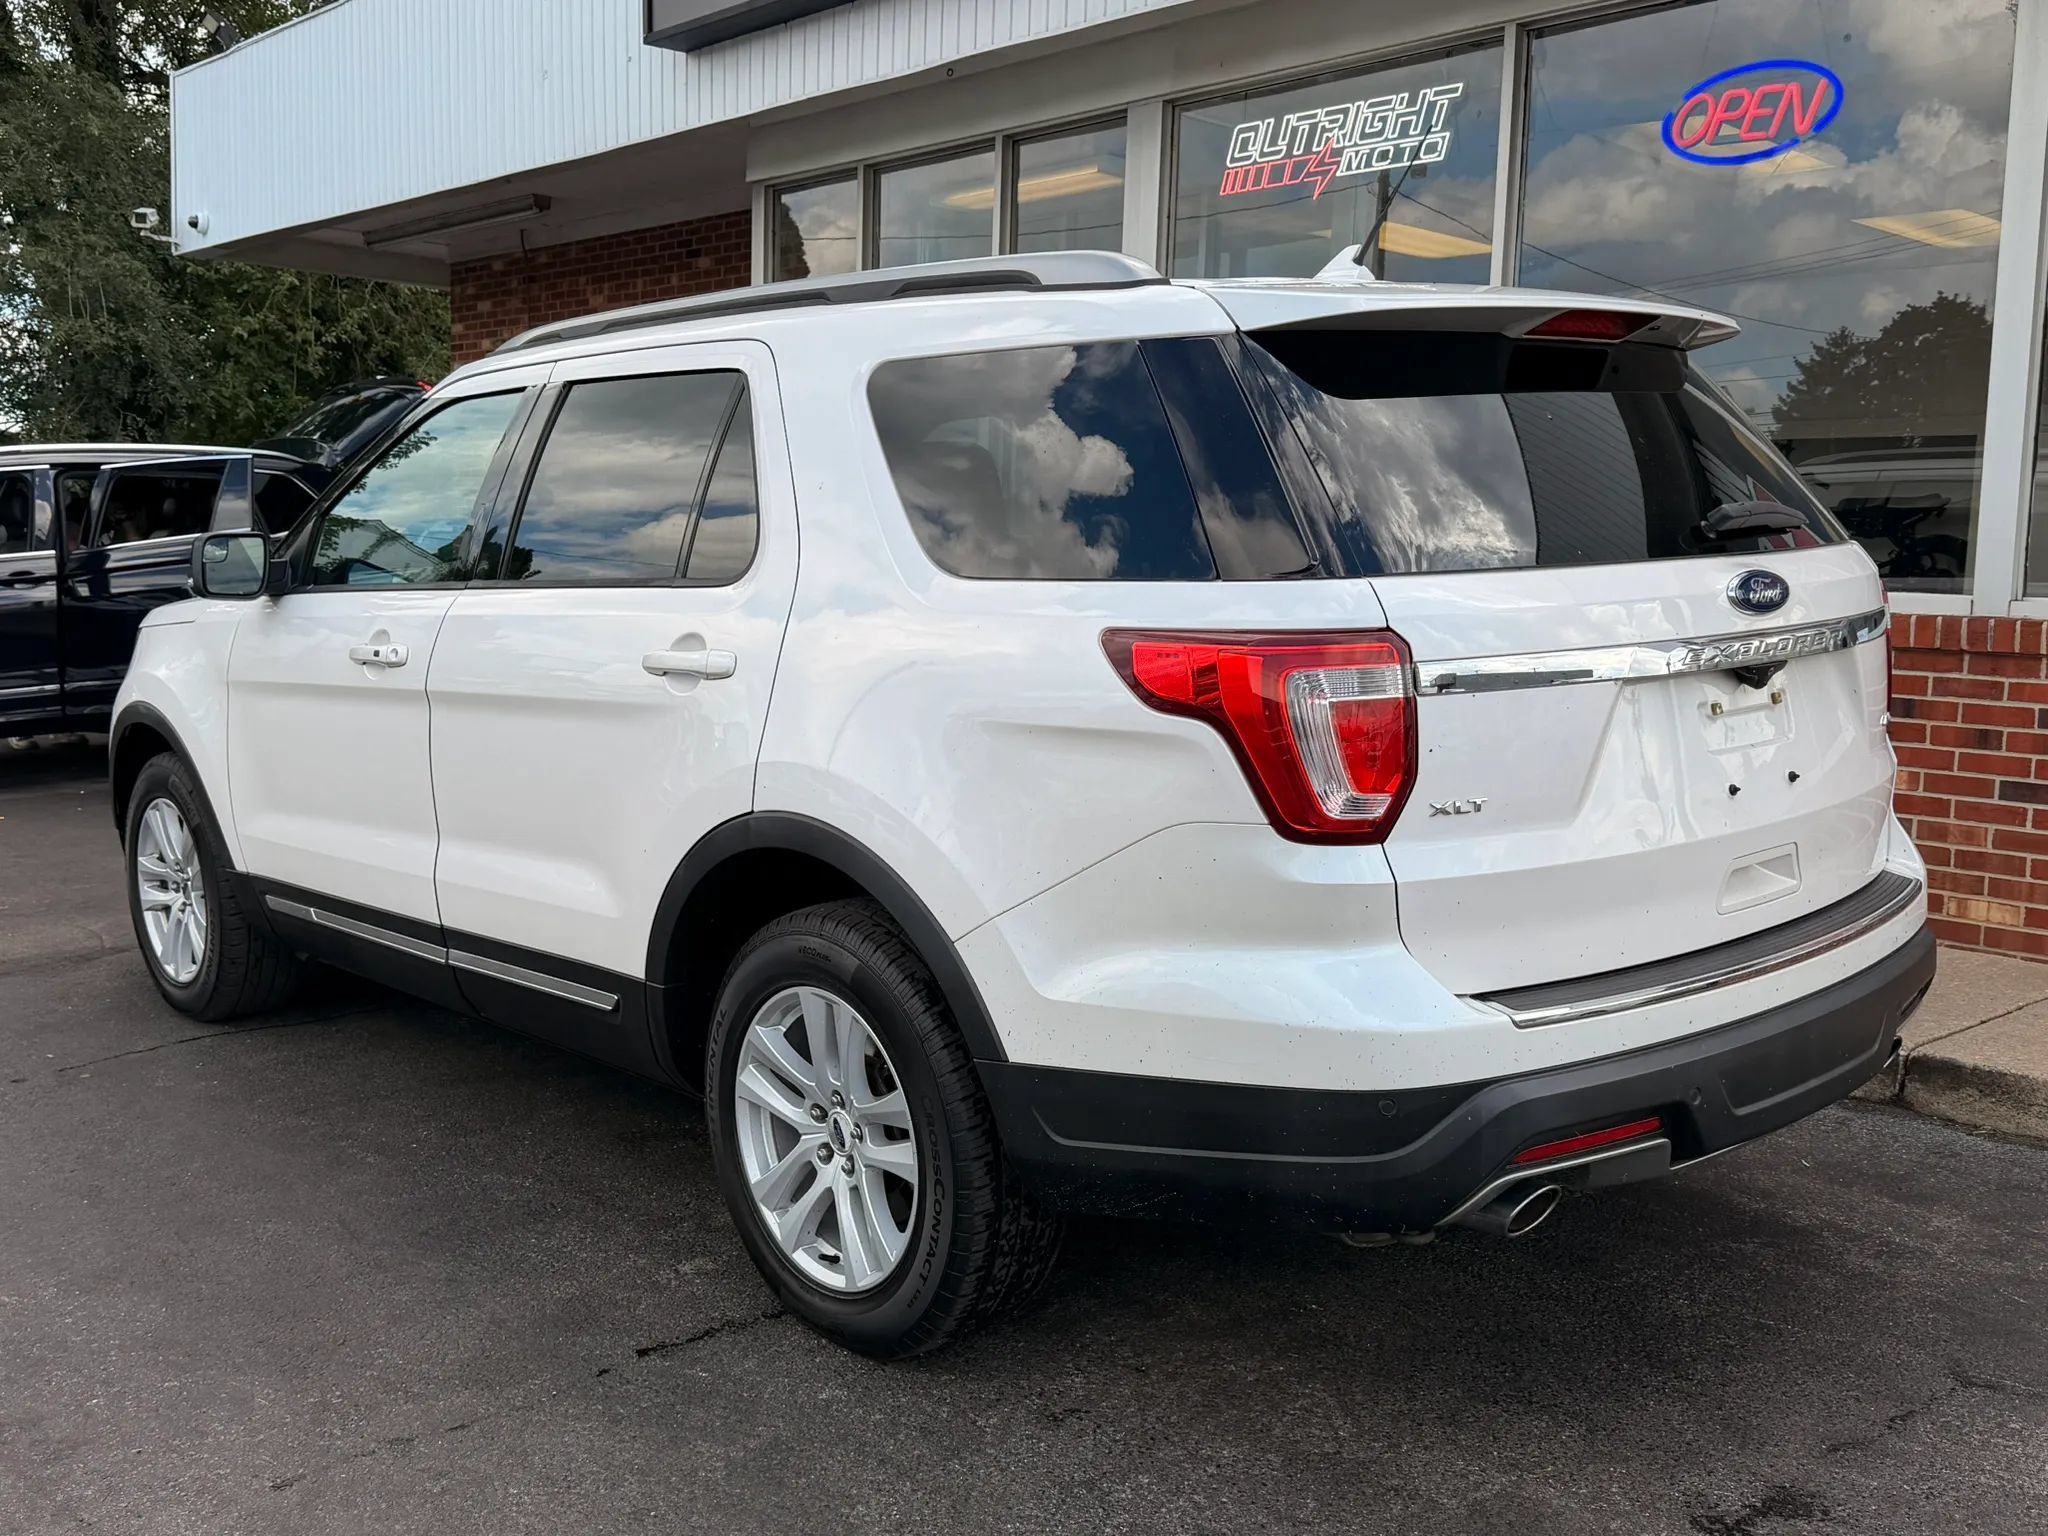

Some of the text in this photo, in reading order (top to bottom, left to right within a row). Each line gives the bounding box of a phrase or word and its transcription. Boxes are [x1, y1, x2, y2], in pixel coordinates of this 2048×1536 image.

[1227, 82, 1464, 168] OUTRIGHT
[1672, 78, 1829, 149] OPEN
[1340, 136, 1443, 174] MOTO
[1749, 577, 1784, 604] Ford
[1682, 627, 1845, 666] EXPLORER
[1429, 796, 1488, 817] XLT
